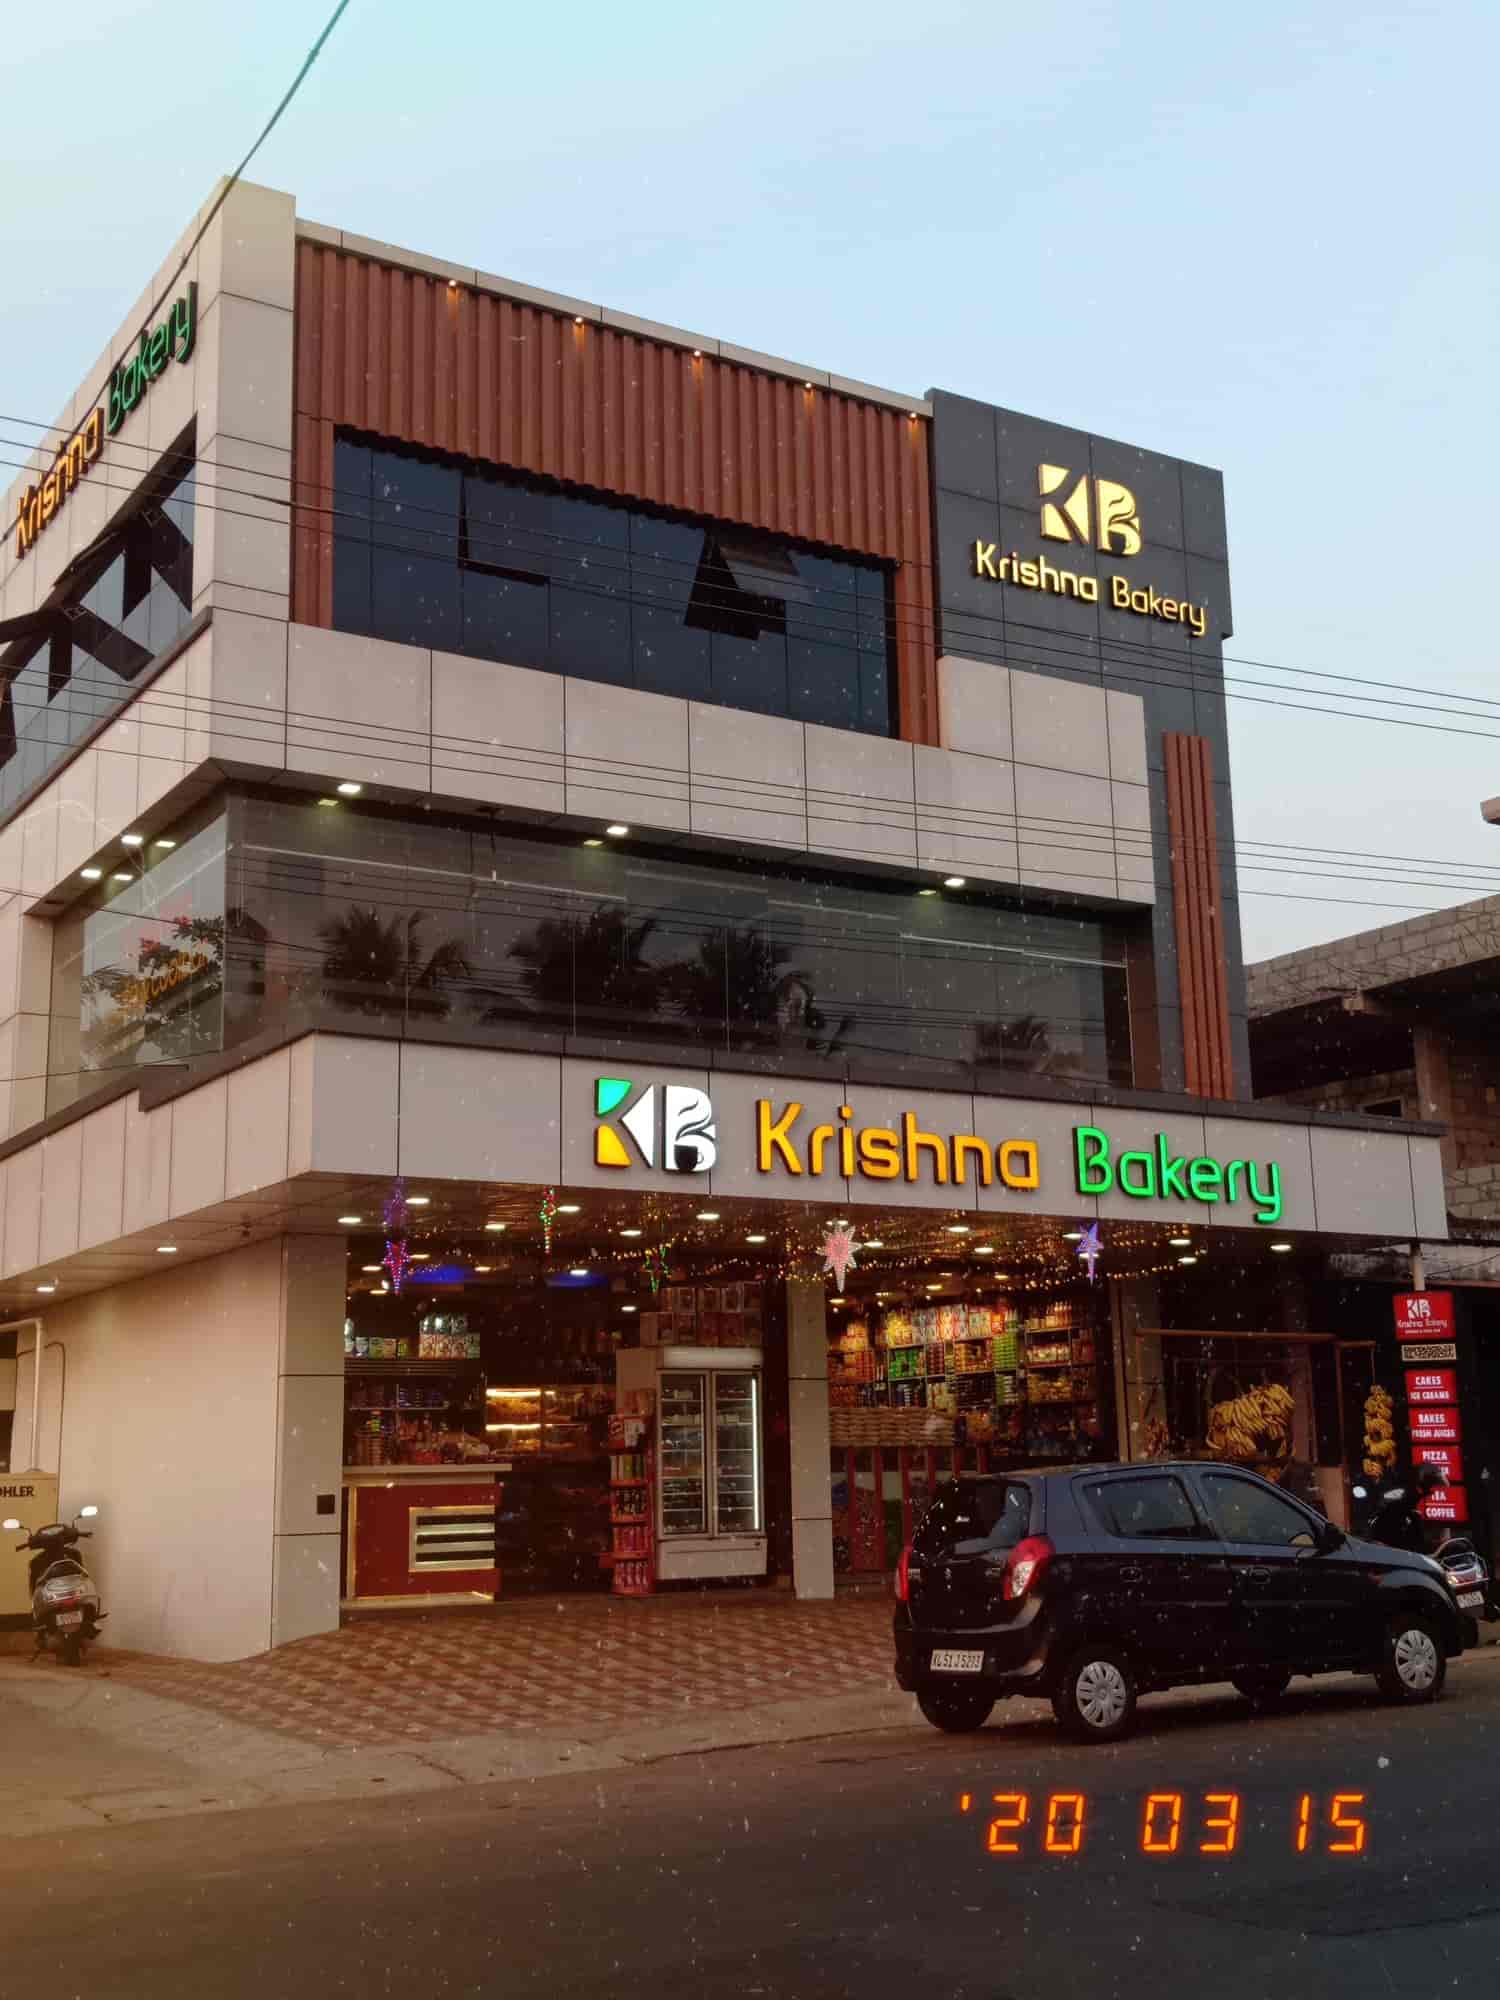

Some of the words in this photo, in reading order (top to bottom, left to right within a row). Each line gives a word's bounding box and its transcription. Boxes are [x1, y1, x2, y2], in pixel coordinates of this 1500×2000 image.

[16, 407, 105, 560] Krishna
[106, 281, 198, 436] Bakery
[973, 538, 1099, 602] Krishna
[1111, 575, 1207, 637] Bakery
[757, 1098, 1041, 1191] Krishna
[1073, 1126, 1282, 1224] Bakery
[1415, 1375, 1442, 1386] CAKES
[1418, 1413, 1446, 1424] BAKES
[1422, 1450, 1449, 1461] PIZZA
[1425, 1507, 1456, 1518] COFFEE
